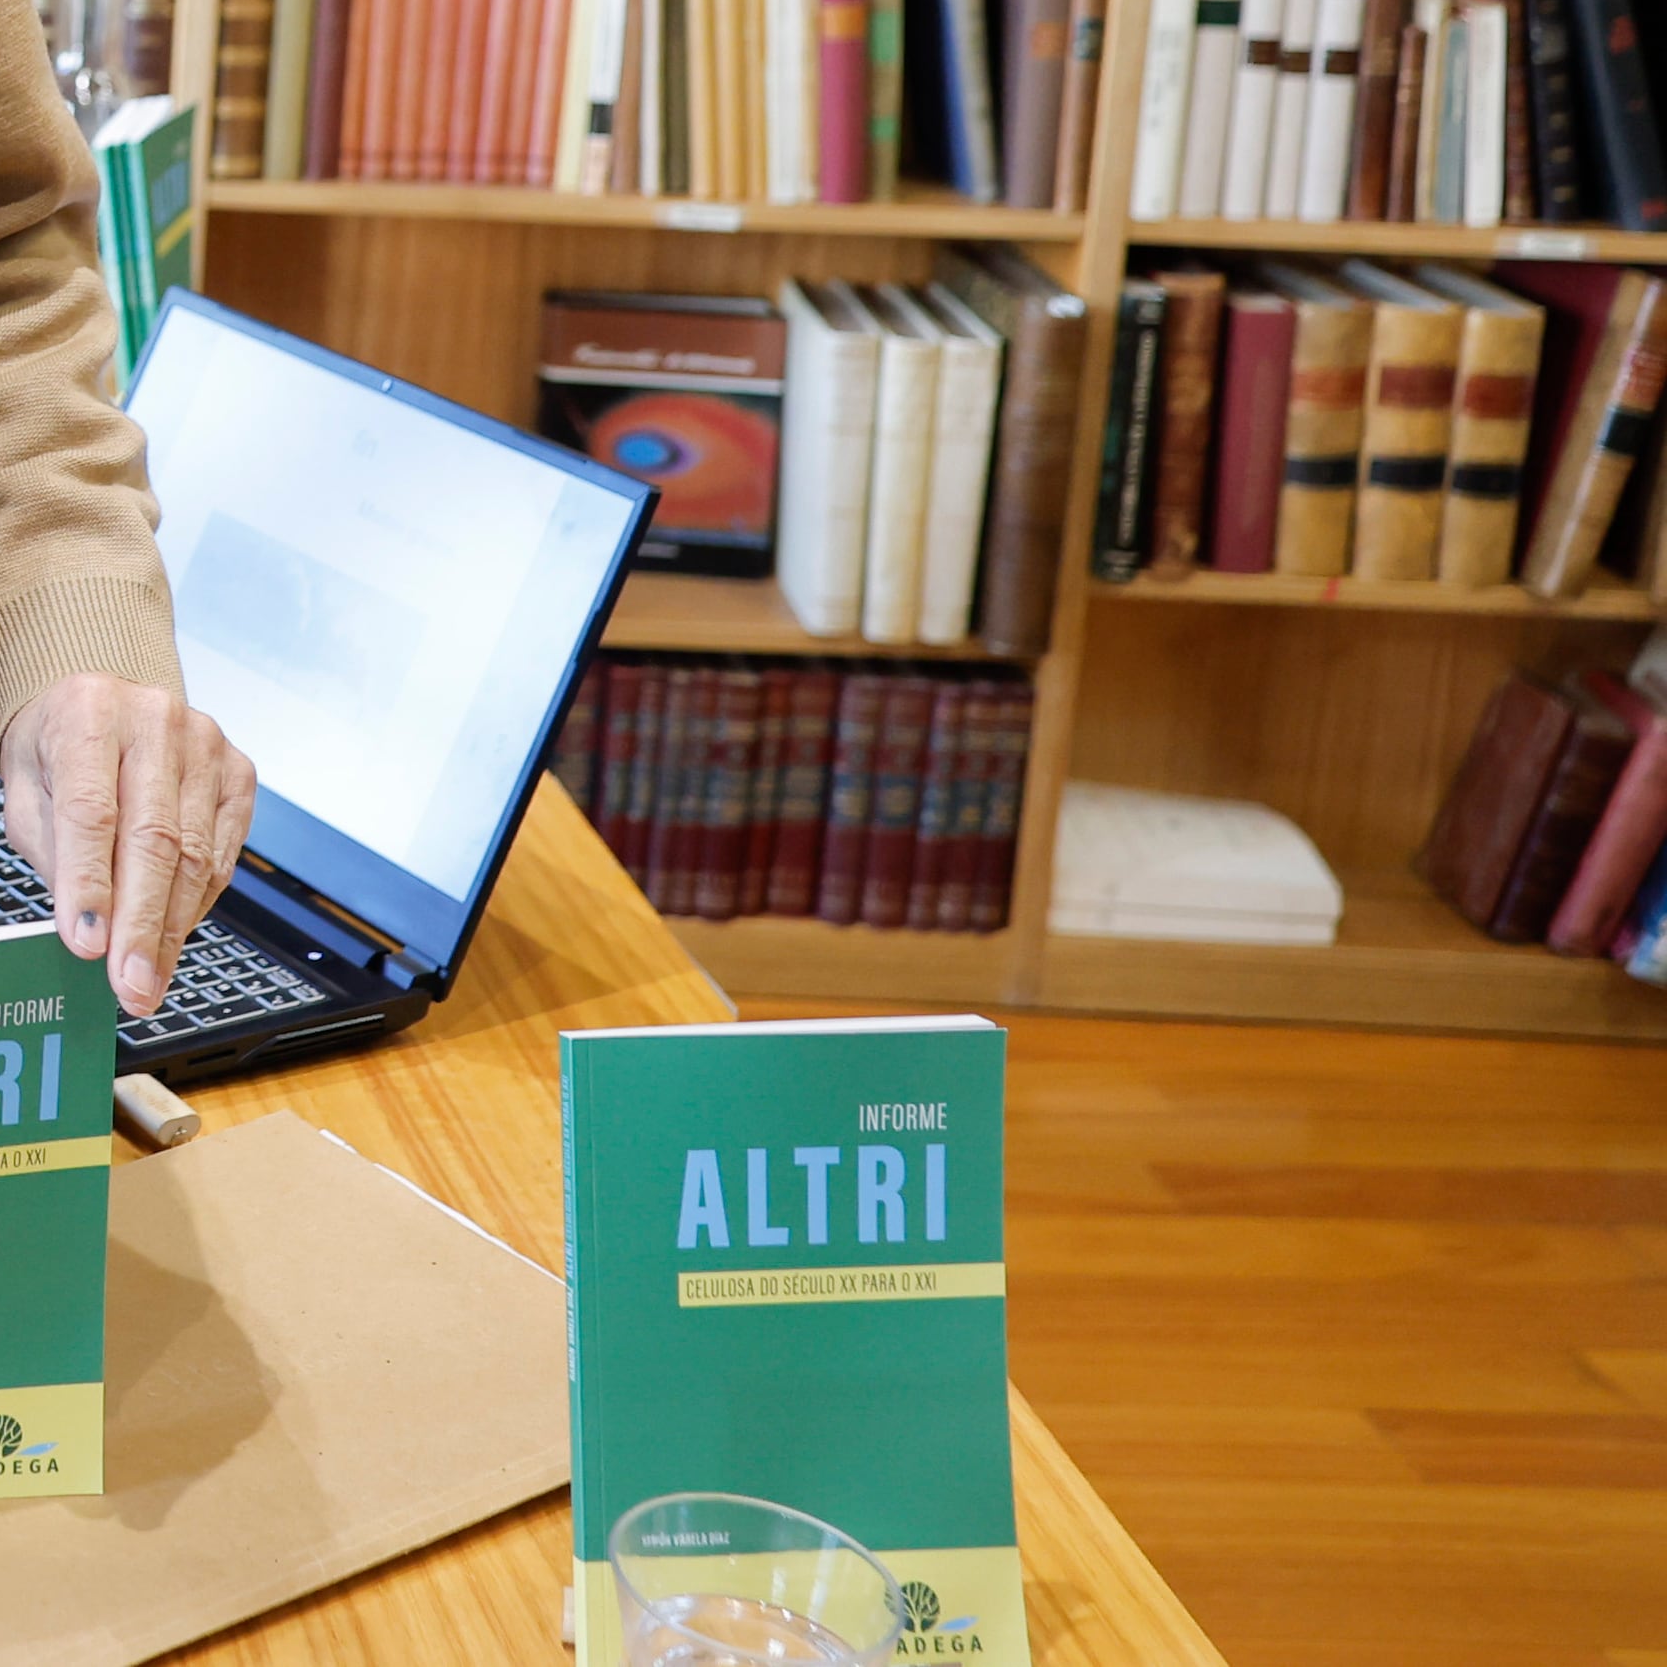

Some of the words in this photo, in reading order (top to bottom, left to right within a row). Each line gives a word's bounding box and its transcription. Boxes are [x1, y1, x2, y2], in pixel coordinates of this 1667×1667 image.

[858, 1102, 948, 1132] INFORME
[13, 1150, 22, 1168] O
[26, 1147, 47, 1166] XXI
[676, 1142, 947, 1249] ALTRI
[686, 1277, 755, 1300] CELULOSA
[760, 1276, 778, 1296] DO
[783, 1272, 836, 1296] SÉCULO
[840, 1275, 857, 1294] XX
[862, 1273, 898, 1293] PARA
[901, 1272, 911, 1291] O
[915, 1271, 937, 1291] XXI
[896, 1634, 984, 1655] ADEGA
